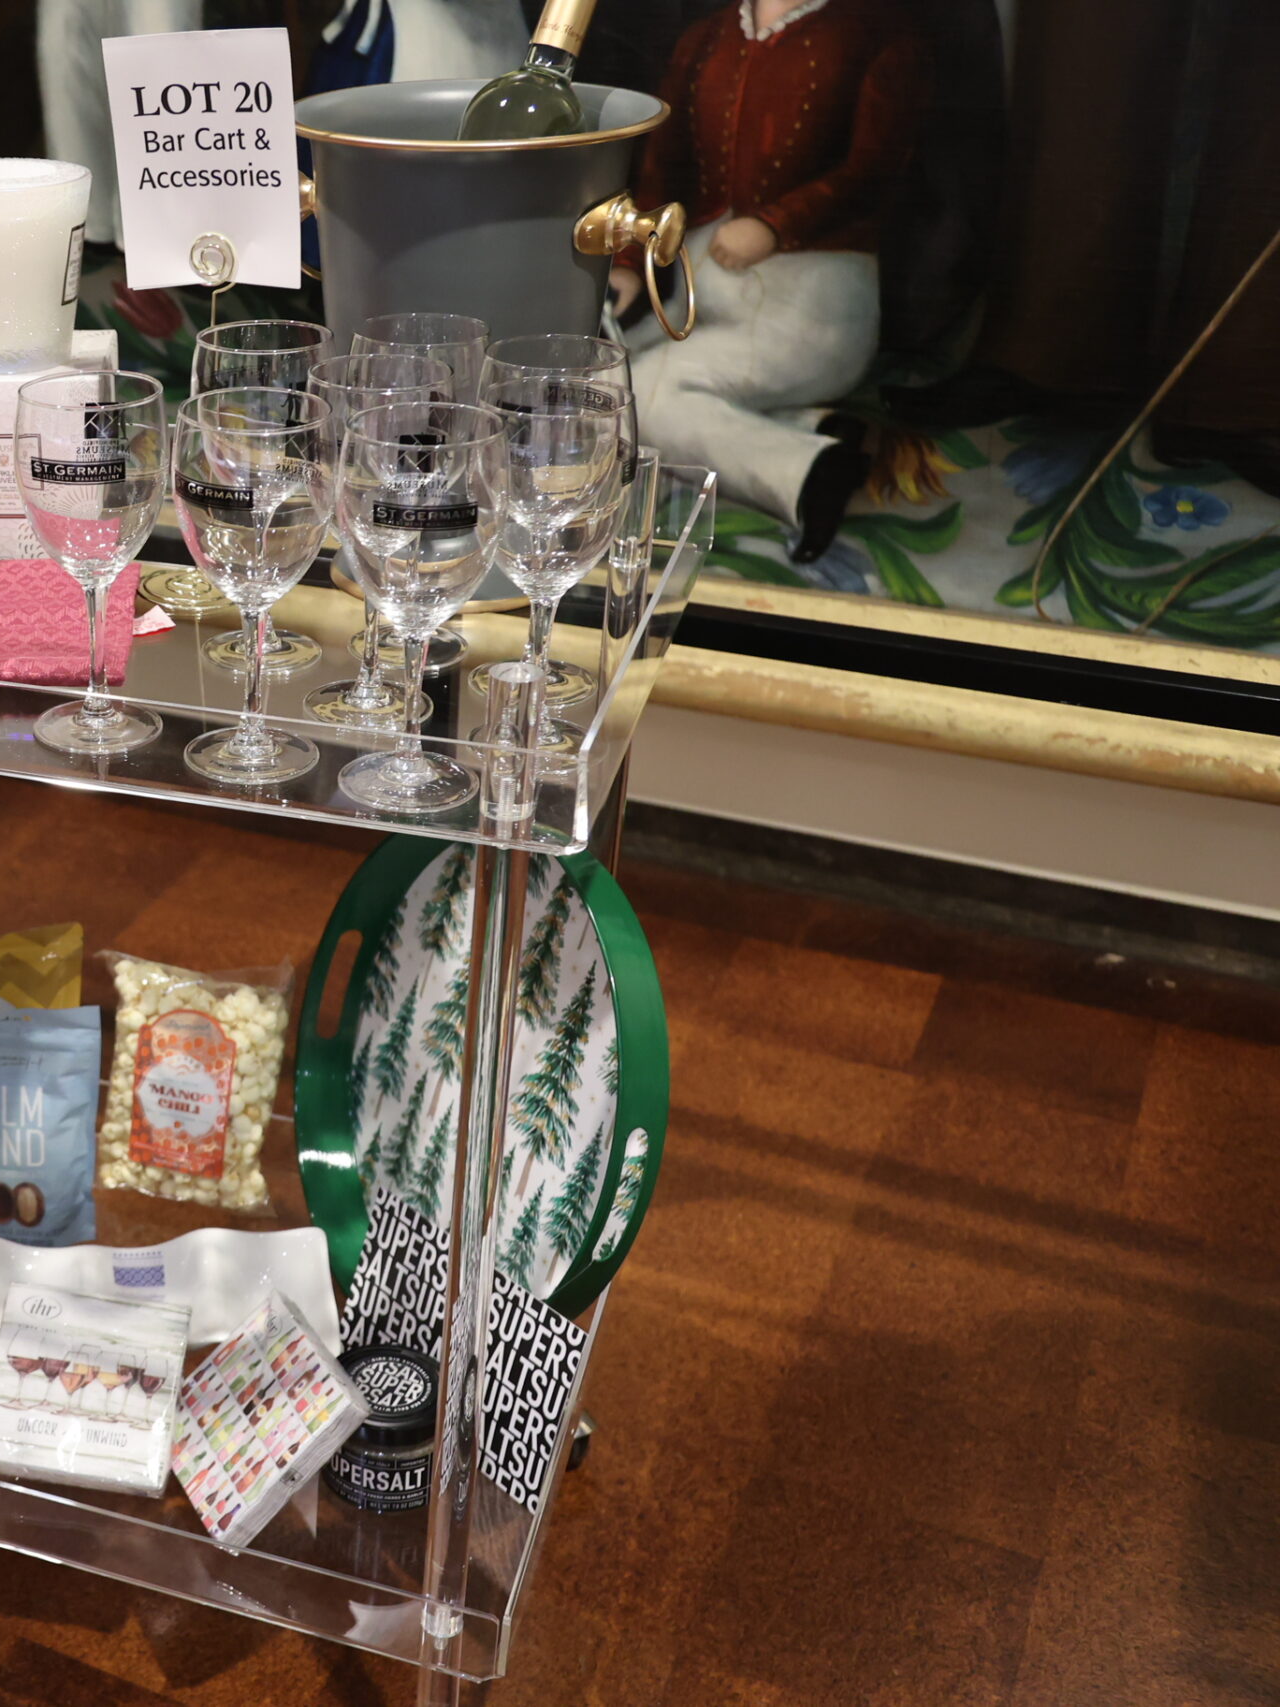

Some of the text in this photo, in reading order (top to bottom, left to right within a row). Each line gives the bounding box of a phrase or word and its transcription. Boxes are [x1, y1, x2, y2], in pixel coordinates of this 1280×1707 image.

[131, 81, 273, 117] LOT 20
[143, 127, 272, 153] Bar Cart &
[139, 162, 282, 190] Accessories
[54, 463, 123, 476] GERMAIN
[187, 482, 250, 501] GERMAIN
[403, 508, 476, 521] GERMAIN
[149, 1083, 215, 1105] MANGO
[358, 1367, 424, 1400] SUPER
[17, 1418, 128, 1448] UNCORK UNWIND
